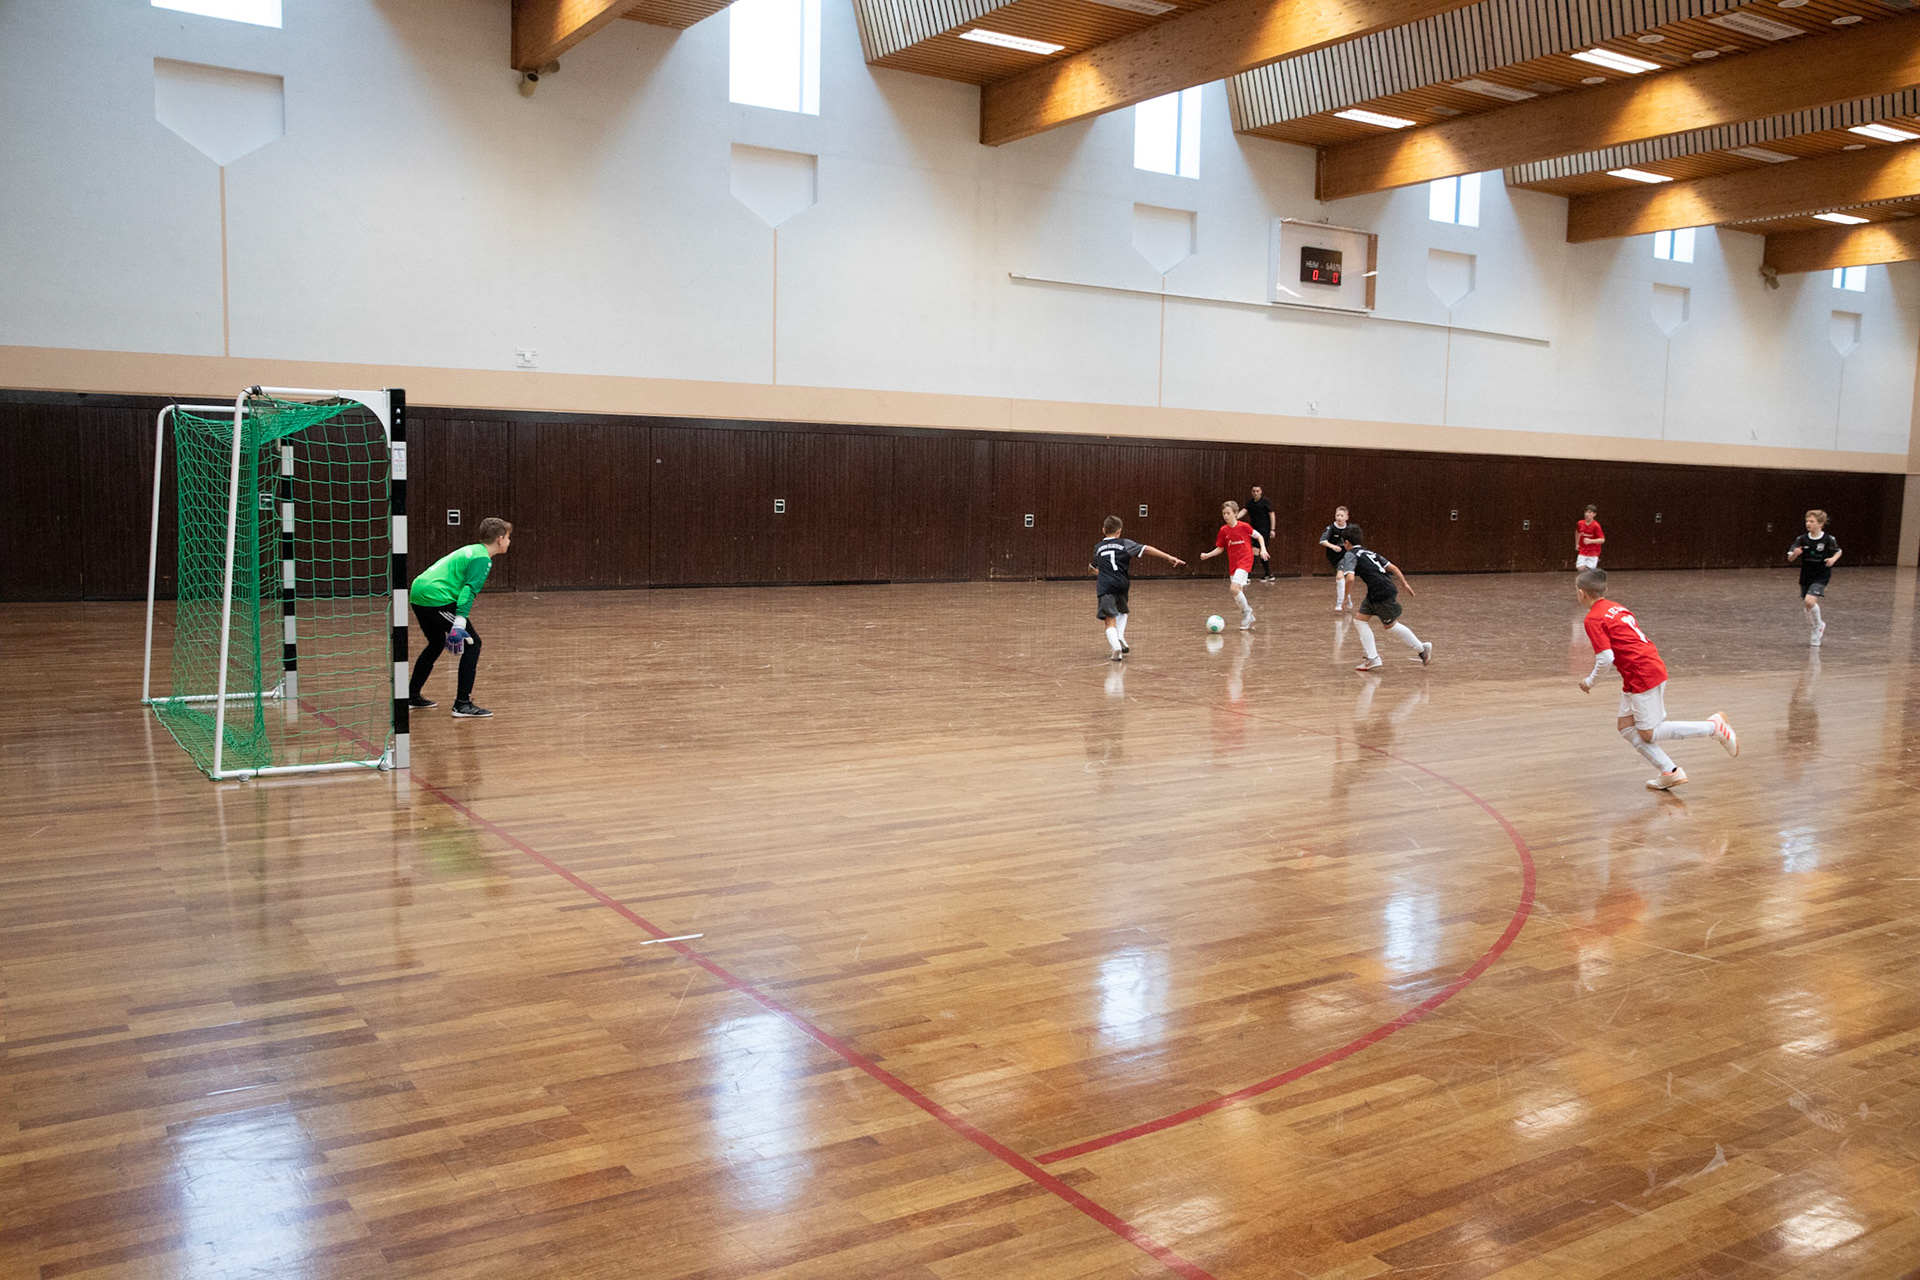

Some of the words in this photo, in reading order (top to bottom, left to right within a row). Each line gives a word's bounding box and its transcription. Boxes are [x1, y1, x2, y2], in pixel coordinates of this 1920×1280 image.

[1312, 269, 1319, 281] 0
[1332, 273, 1339, 283] 0
[1100, 550, 1118, 571] 7
